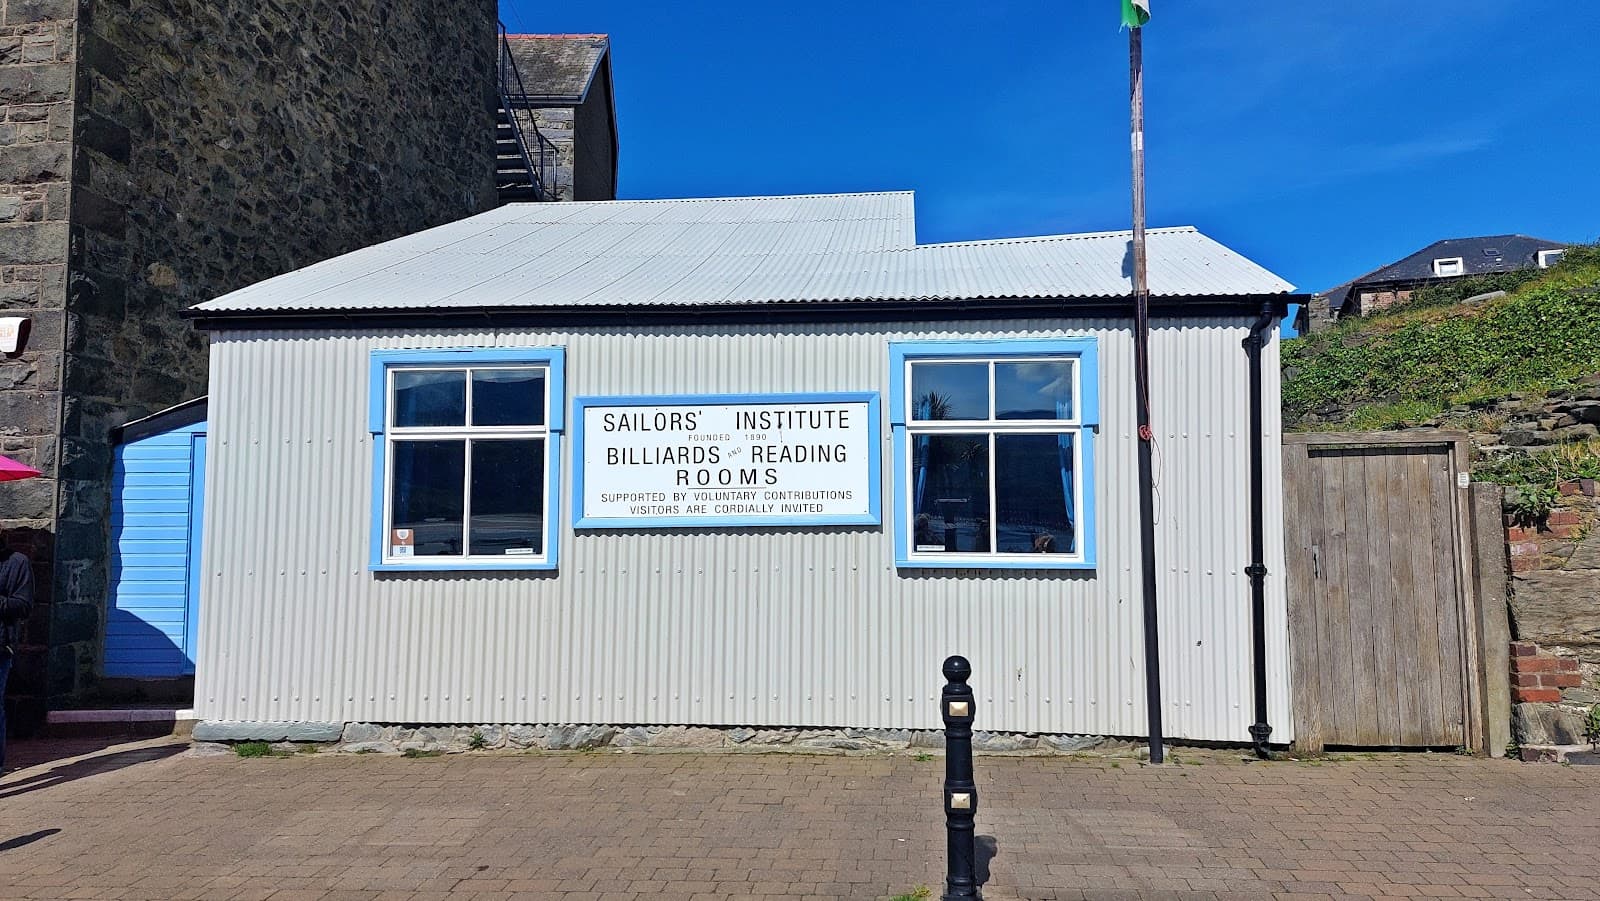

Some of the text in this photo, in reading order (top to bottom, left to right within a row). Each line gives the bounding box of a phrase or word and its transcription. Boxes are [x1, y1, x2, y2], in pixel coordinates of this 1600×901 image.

[603, 410, 850, 432] SAILORS' INSTITUTE
[688, 433, 767, 442] FOUNDED 1890
[607, 444, 847, 465] BILLIARDS AND READING
[676, 468, 778, 486] ROOMS
[601, 490, 853, 503] SUPPORTED BY VOLUNTARY CONTRIBUTIONS
[630, 503, 824, 515] VISITORS ARE CORDIALLY INVITED
